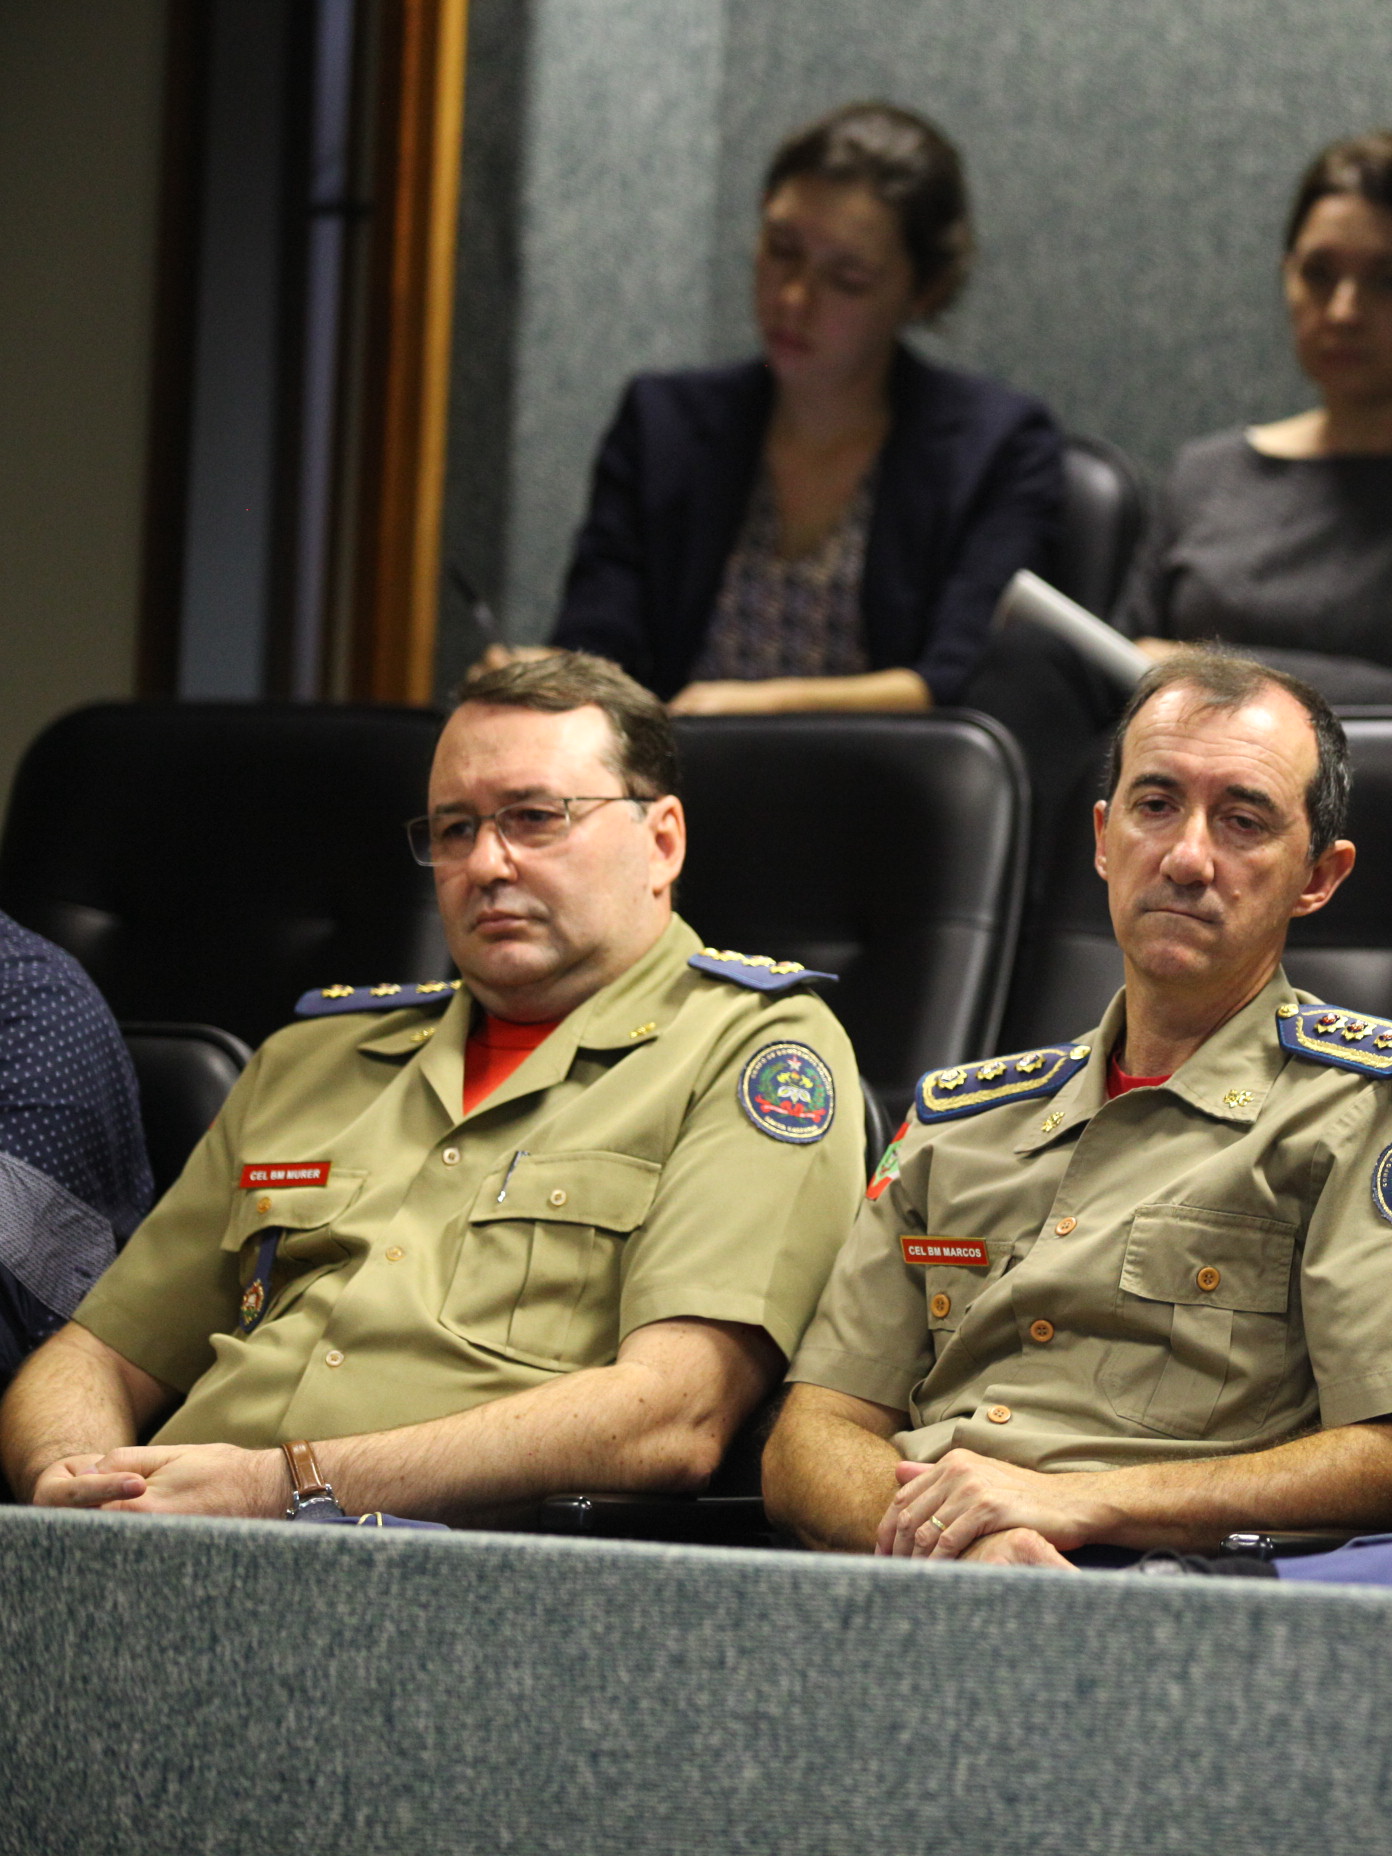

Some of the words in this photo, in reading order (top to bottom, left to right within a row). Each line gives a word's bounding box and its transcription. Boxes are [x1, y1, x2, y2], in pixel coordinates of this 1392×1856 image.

[249, 1170, 268, 1181] CEL
[270, 1169, 286, 1180] BM
[286, 1168, 321, 1180] MURER
[908, 1245, 927, 1256] CEL
[927, 1246, 941, 1256] BM
[942, 1246, 981, 1258] MARCOS
